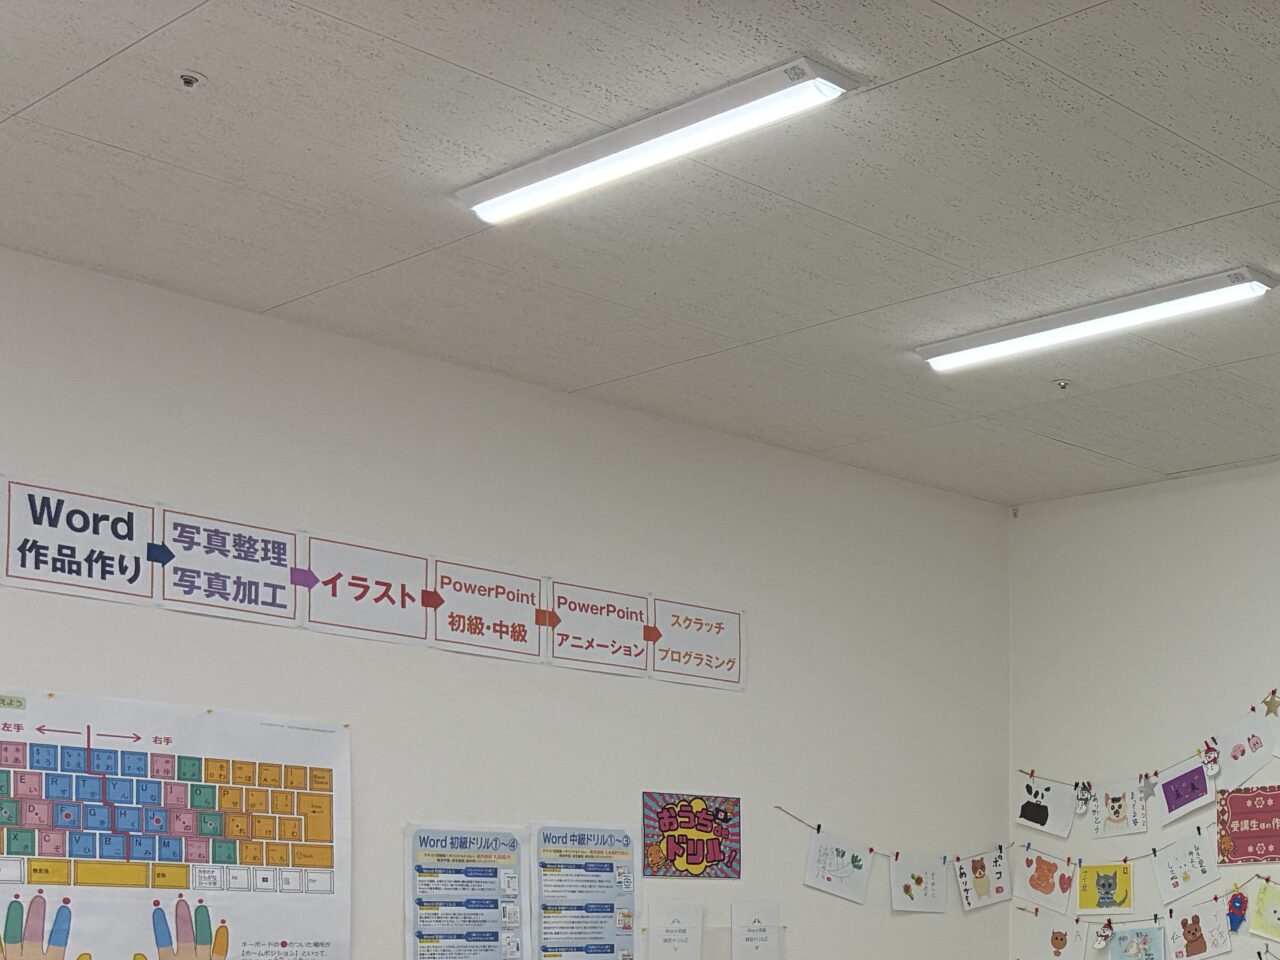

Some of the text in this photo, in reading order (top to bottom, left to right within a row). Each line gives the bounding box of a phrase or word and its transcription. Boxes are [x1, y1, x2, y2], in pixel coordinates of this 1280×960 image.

[28, 493, 134, 541] Word
[172, 522, 288, 568] 写真整理
[17, 538, 141, 584] 作品作り
[172, 566, 288, 609] 写真加工
[322, 571, 416, 609] イラスト
[440, 575, 536, 606] PowerPoint
[557, 595, 644, 623] PowerPoint
[447, 611, 528, 644] 初級・中級
[671, 613, 725, 635] スクラッチ
[557, 632, 645, 659] アニメーション
[659, 647, 736, 672] プログラミング
[1, 722, 24, 732] 左手
[152, 736, 173, 745] 右手
[19, 775, 26, 784] E
[51, 778, 58, 786] R
[81, 780, 86, 788] T
[112, 782, 117, 790] Y
[170, 785, 173, 793] I
[28, 805, 35, 813] D
[120, 810, 126, 818] H
[176, 814, 181, 822] K
[12, 833, 19, 841] X
[44, 834, 50, 842] C
[74, 836, 81, 844] V
[136, 839, 142, 847] N
[419, 836, 447, 848] Word
[543, 832, 567, 844] Word
